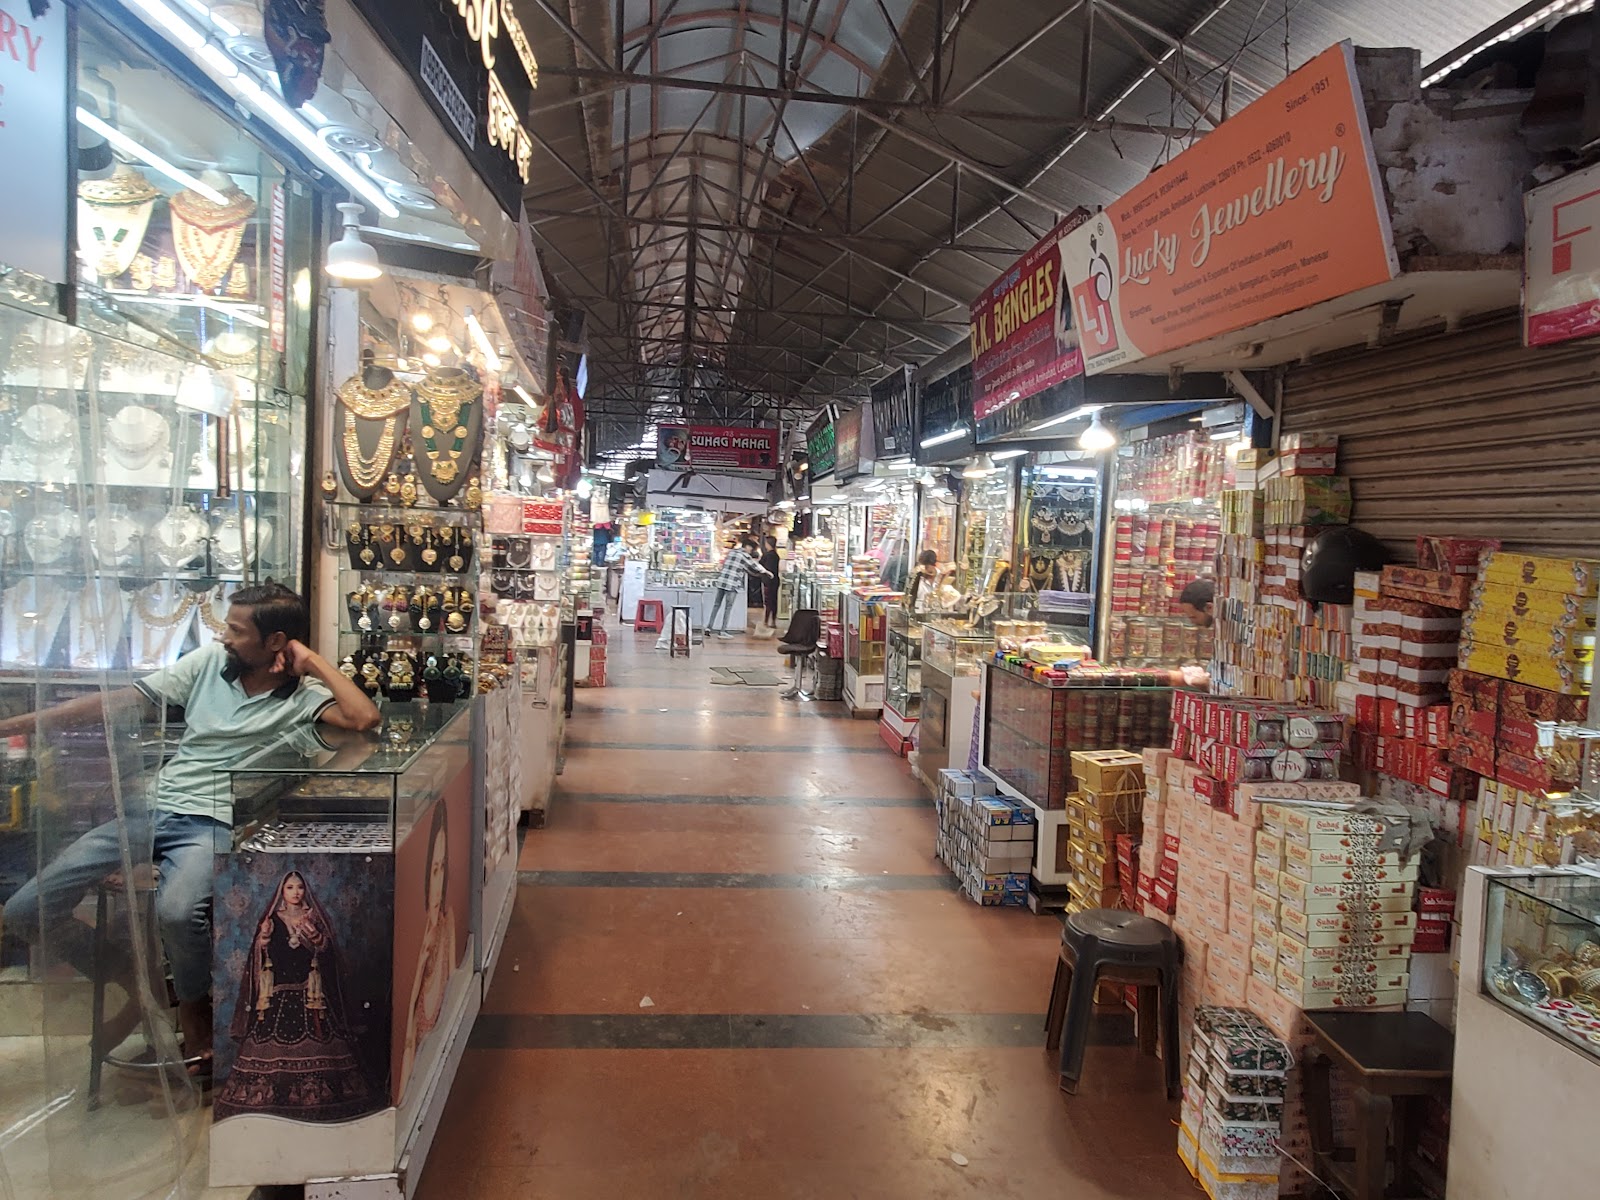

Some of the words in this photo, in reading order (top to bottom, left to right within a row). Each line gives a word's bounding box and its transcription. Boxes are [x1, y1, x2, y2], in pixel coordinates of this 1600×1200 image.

[1310, 75, 1330, 97] 1951
[1121, 231, 1180, 285] Lucky
[1190, 145, 1346, 268] Jewellery
[993, 259, 1054, 344] BANGLES
[692, 436, 729, 447] SUHAG
[732, 438, 771, 449] MAHAL
[1316, 820, 1340, 829] Suhag
[1319, 853, 1343, 862] Suhag
[1313, 885, 1337, 894] Suhag
[1315, 918, 1339, 927] Suhag
[1312, 948, 1335, 957] Suhag
[1312, 979, 1335, 988] Suhag
